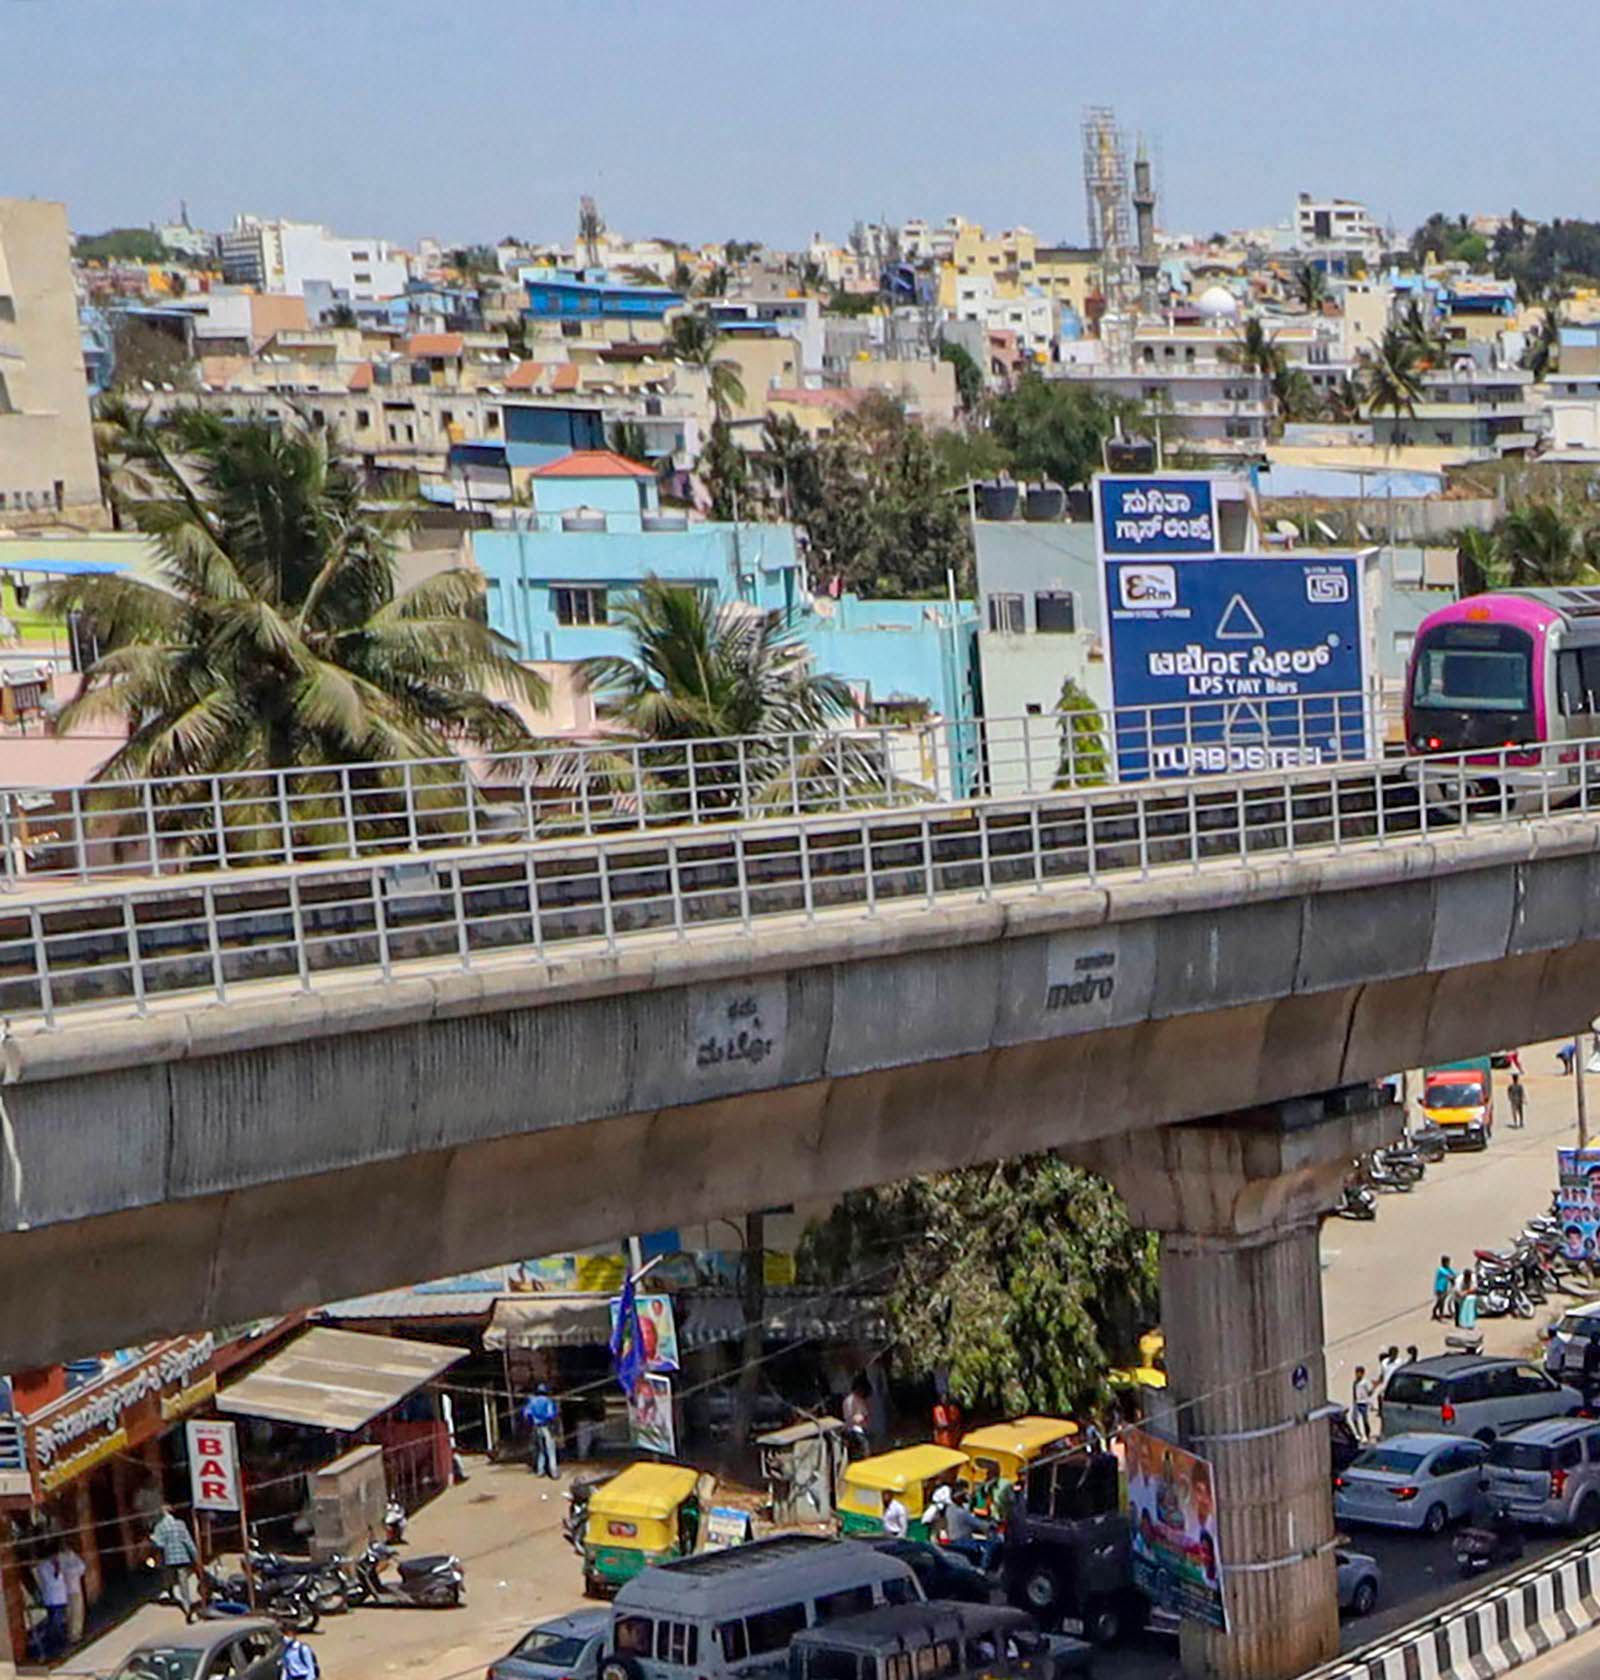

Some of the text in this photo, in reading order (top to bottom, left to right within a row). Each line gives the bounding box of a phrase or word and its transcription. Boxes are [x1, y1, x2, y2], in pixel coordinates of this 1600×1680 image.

[1188, 676, 1223, 695] LPS
[1046, 974, 1114, 1009] metro
[197, 1438, 229, 1501] BAR
